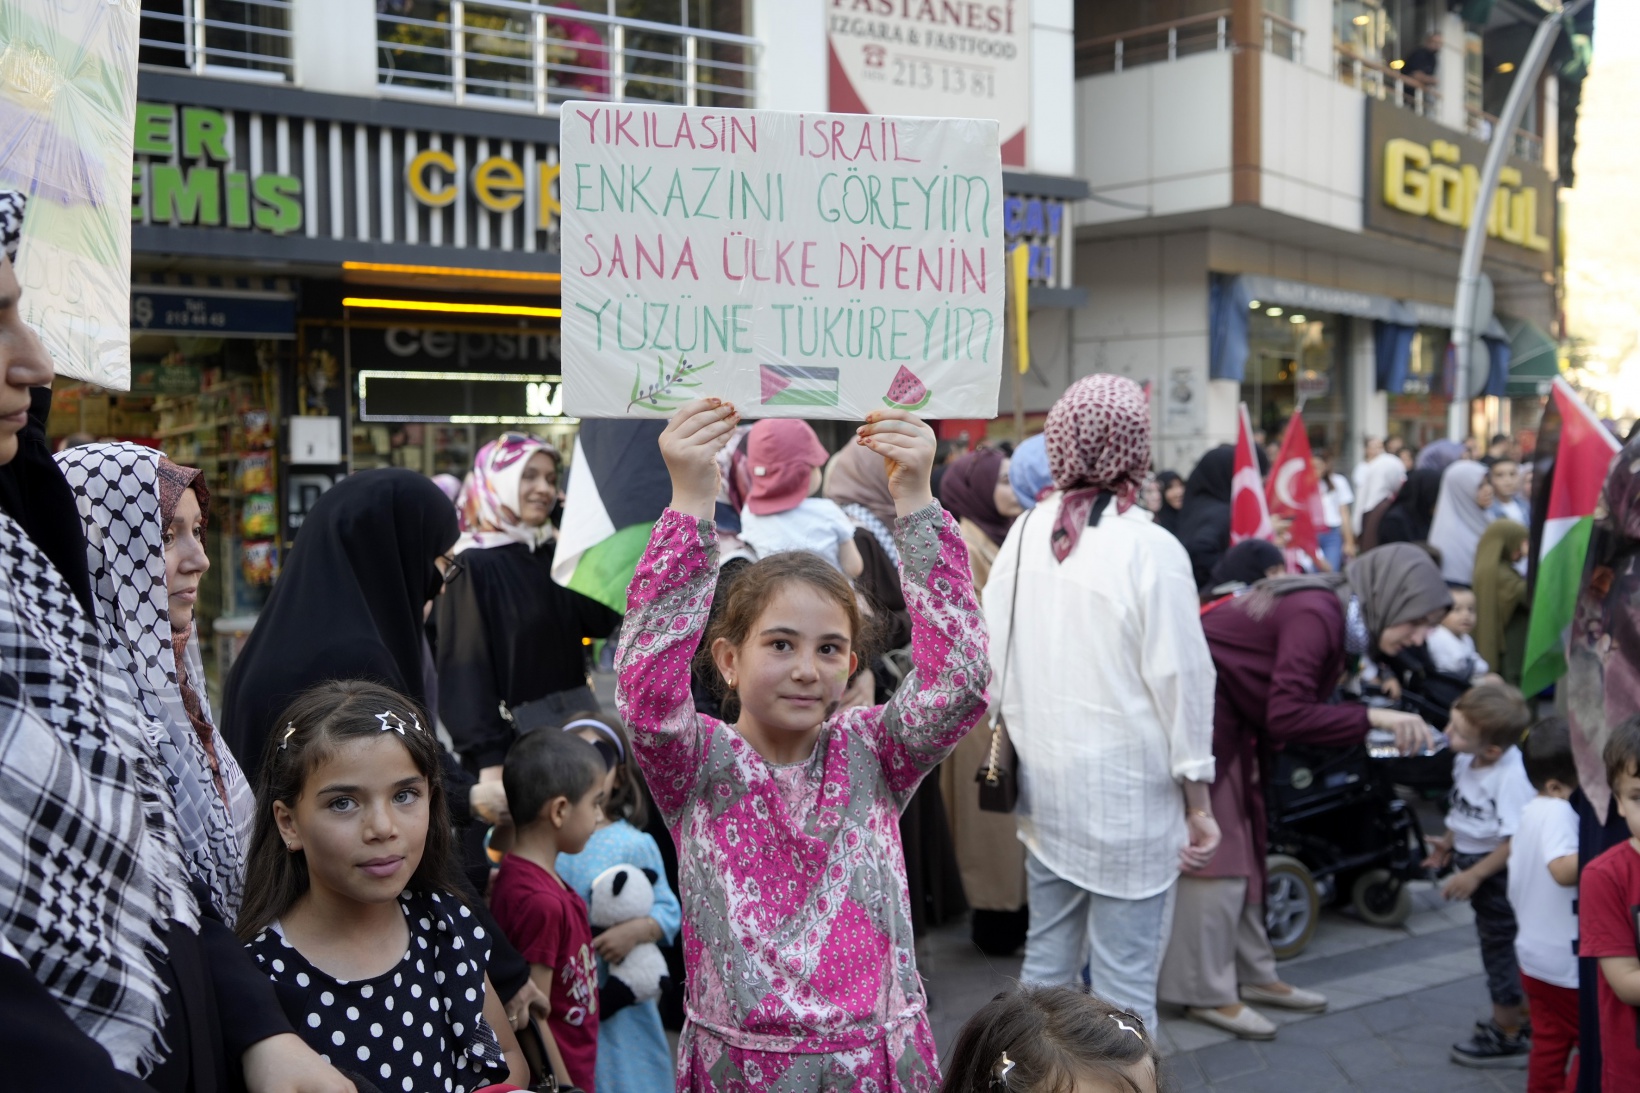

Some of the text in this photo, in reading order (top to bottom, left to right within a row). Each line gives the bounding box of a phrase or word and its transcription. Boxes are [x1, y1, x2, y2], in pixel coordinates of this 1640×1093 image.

[832, 0, 1015, 34] STANESİ
[576, 108, 922, 163] YIKILASIN İSRAİL
[131, 163, 302, 235] MİŞ
[575, 163, 989, 238] ENKAZINI GÖREYİM
[580, 233, 699, 281] SANA
[723, 231, 820, 288] ÜLKE
[837, 236, 986, 294] DİYENİN
[575, 294, 994, 363] YÜZÜNE TÜKÜREYİM
